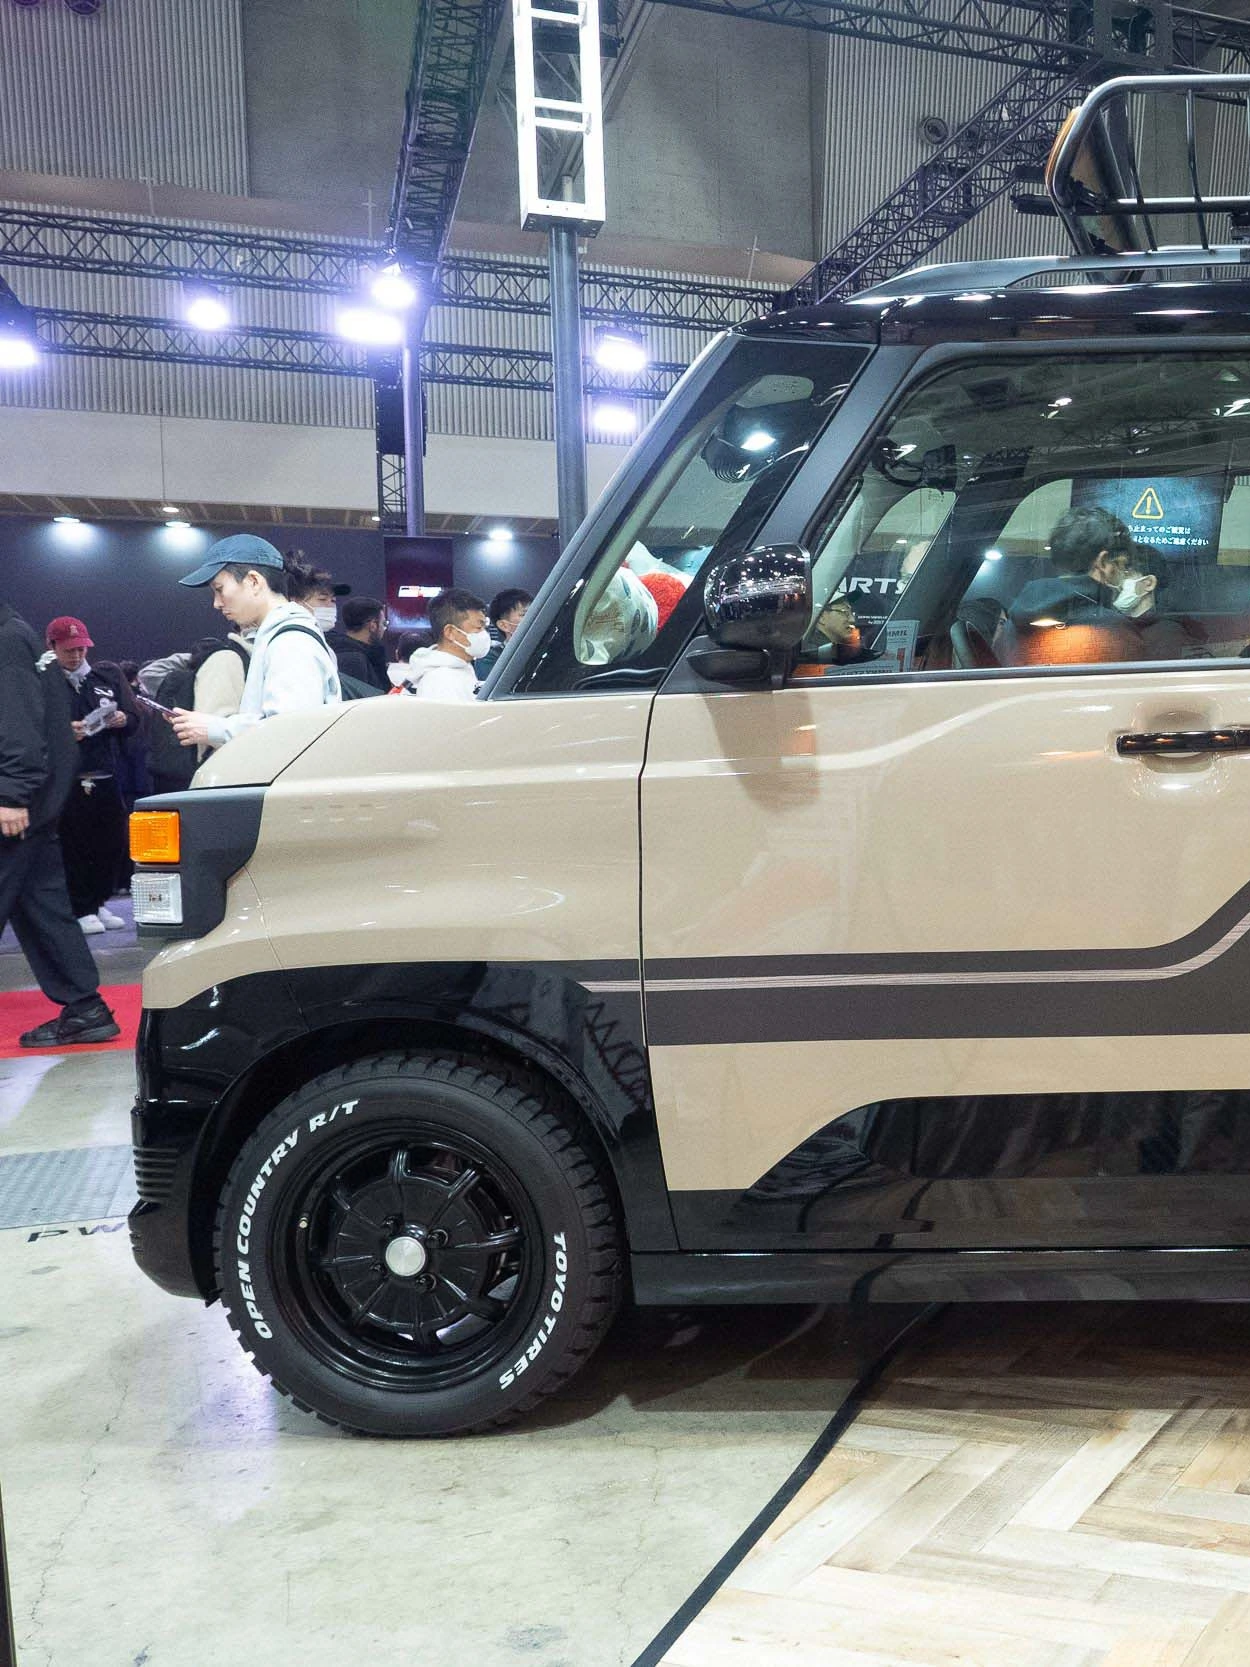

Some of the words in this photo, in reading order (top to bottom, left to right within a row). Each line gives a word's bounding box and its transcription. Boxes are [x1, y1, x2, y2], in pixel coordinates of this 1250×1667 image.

[308, 1099, 360, 1133] R/T
[236, 1128, 300, 1255] COUNTRY
[237, 1260, 273, 1339] OPEN
[551, 1231, 568, 1313] TOYO
[499, 1314, 557, 1390] TIRES
